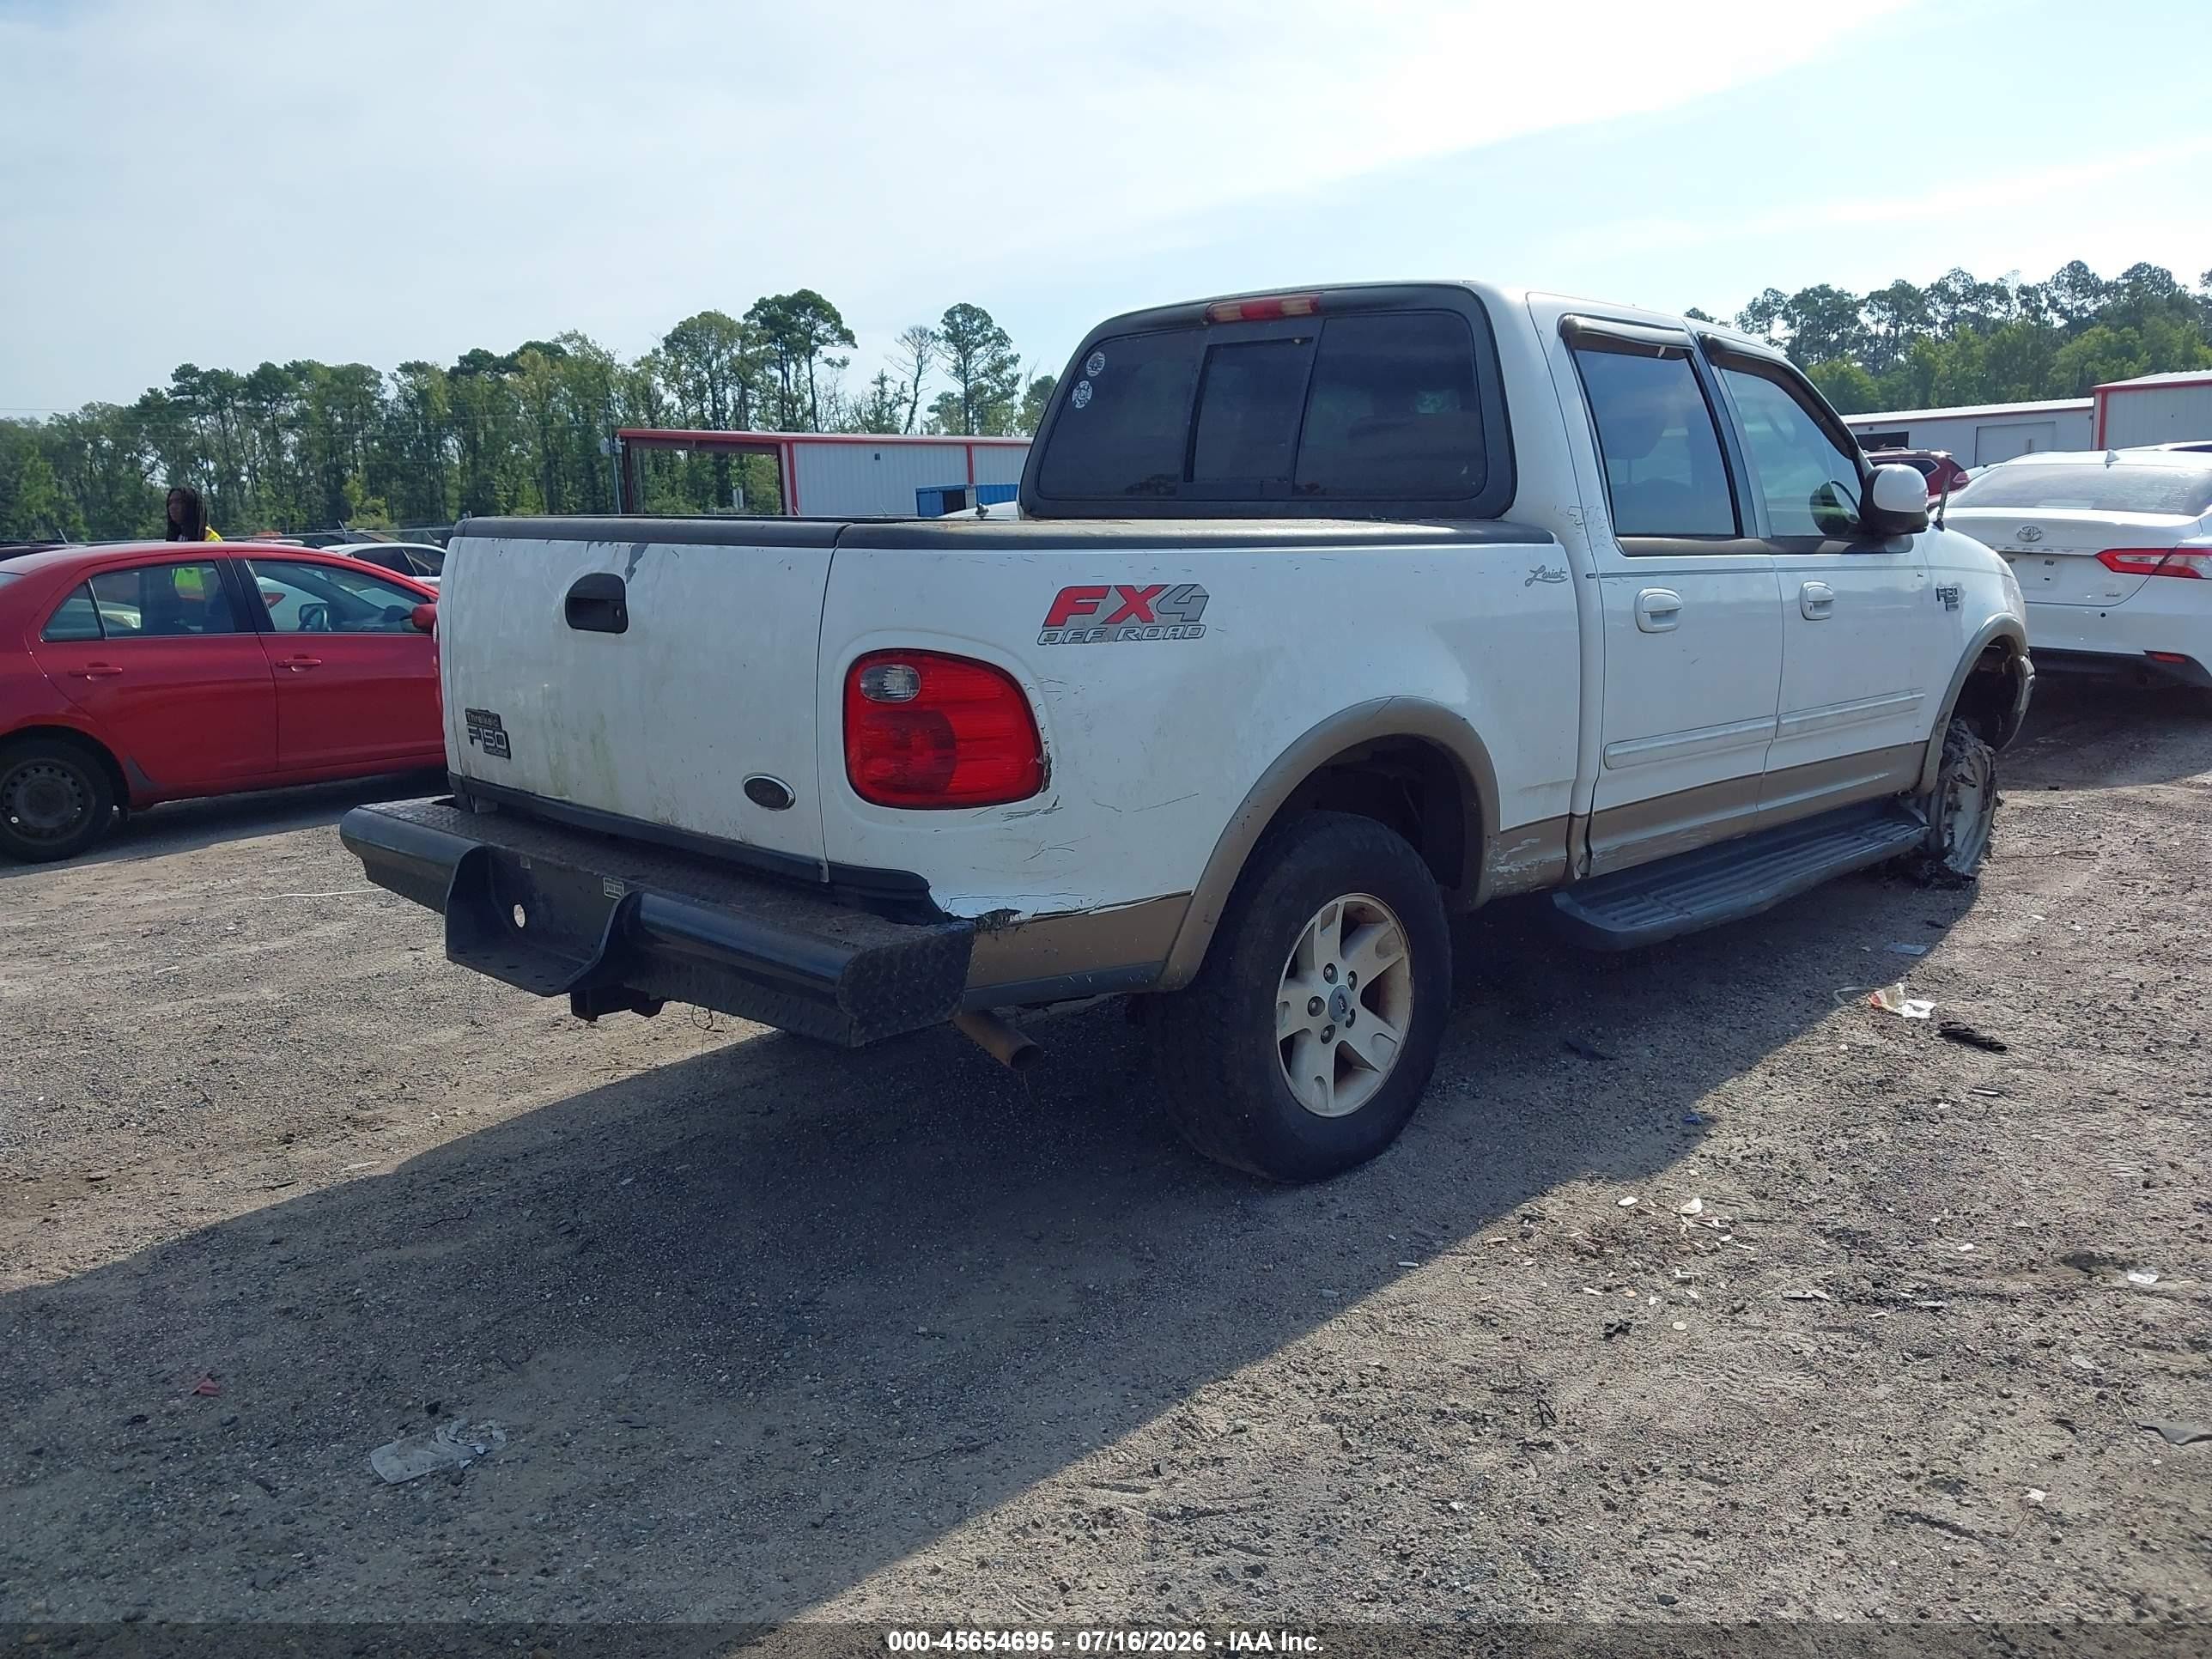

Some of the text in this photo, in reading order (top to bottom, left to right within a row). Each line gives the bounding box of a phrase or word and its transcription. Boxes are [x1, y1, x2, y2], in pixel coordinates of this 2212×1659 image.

[1042, 584, 1210, 627] FX4
[1037, 624, 1206, 646] OFF ROAD
